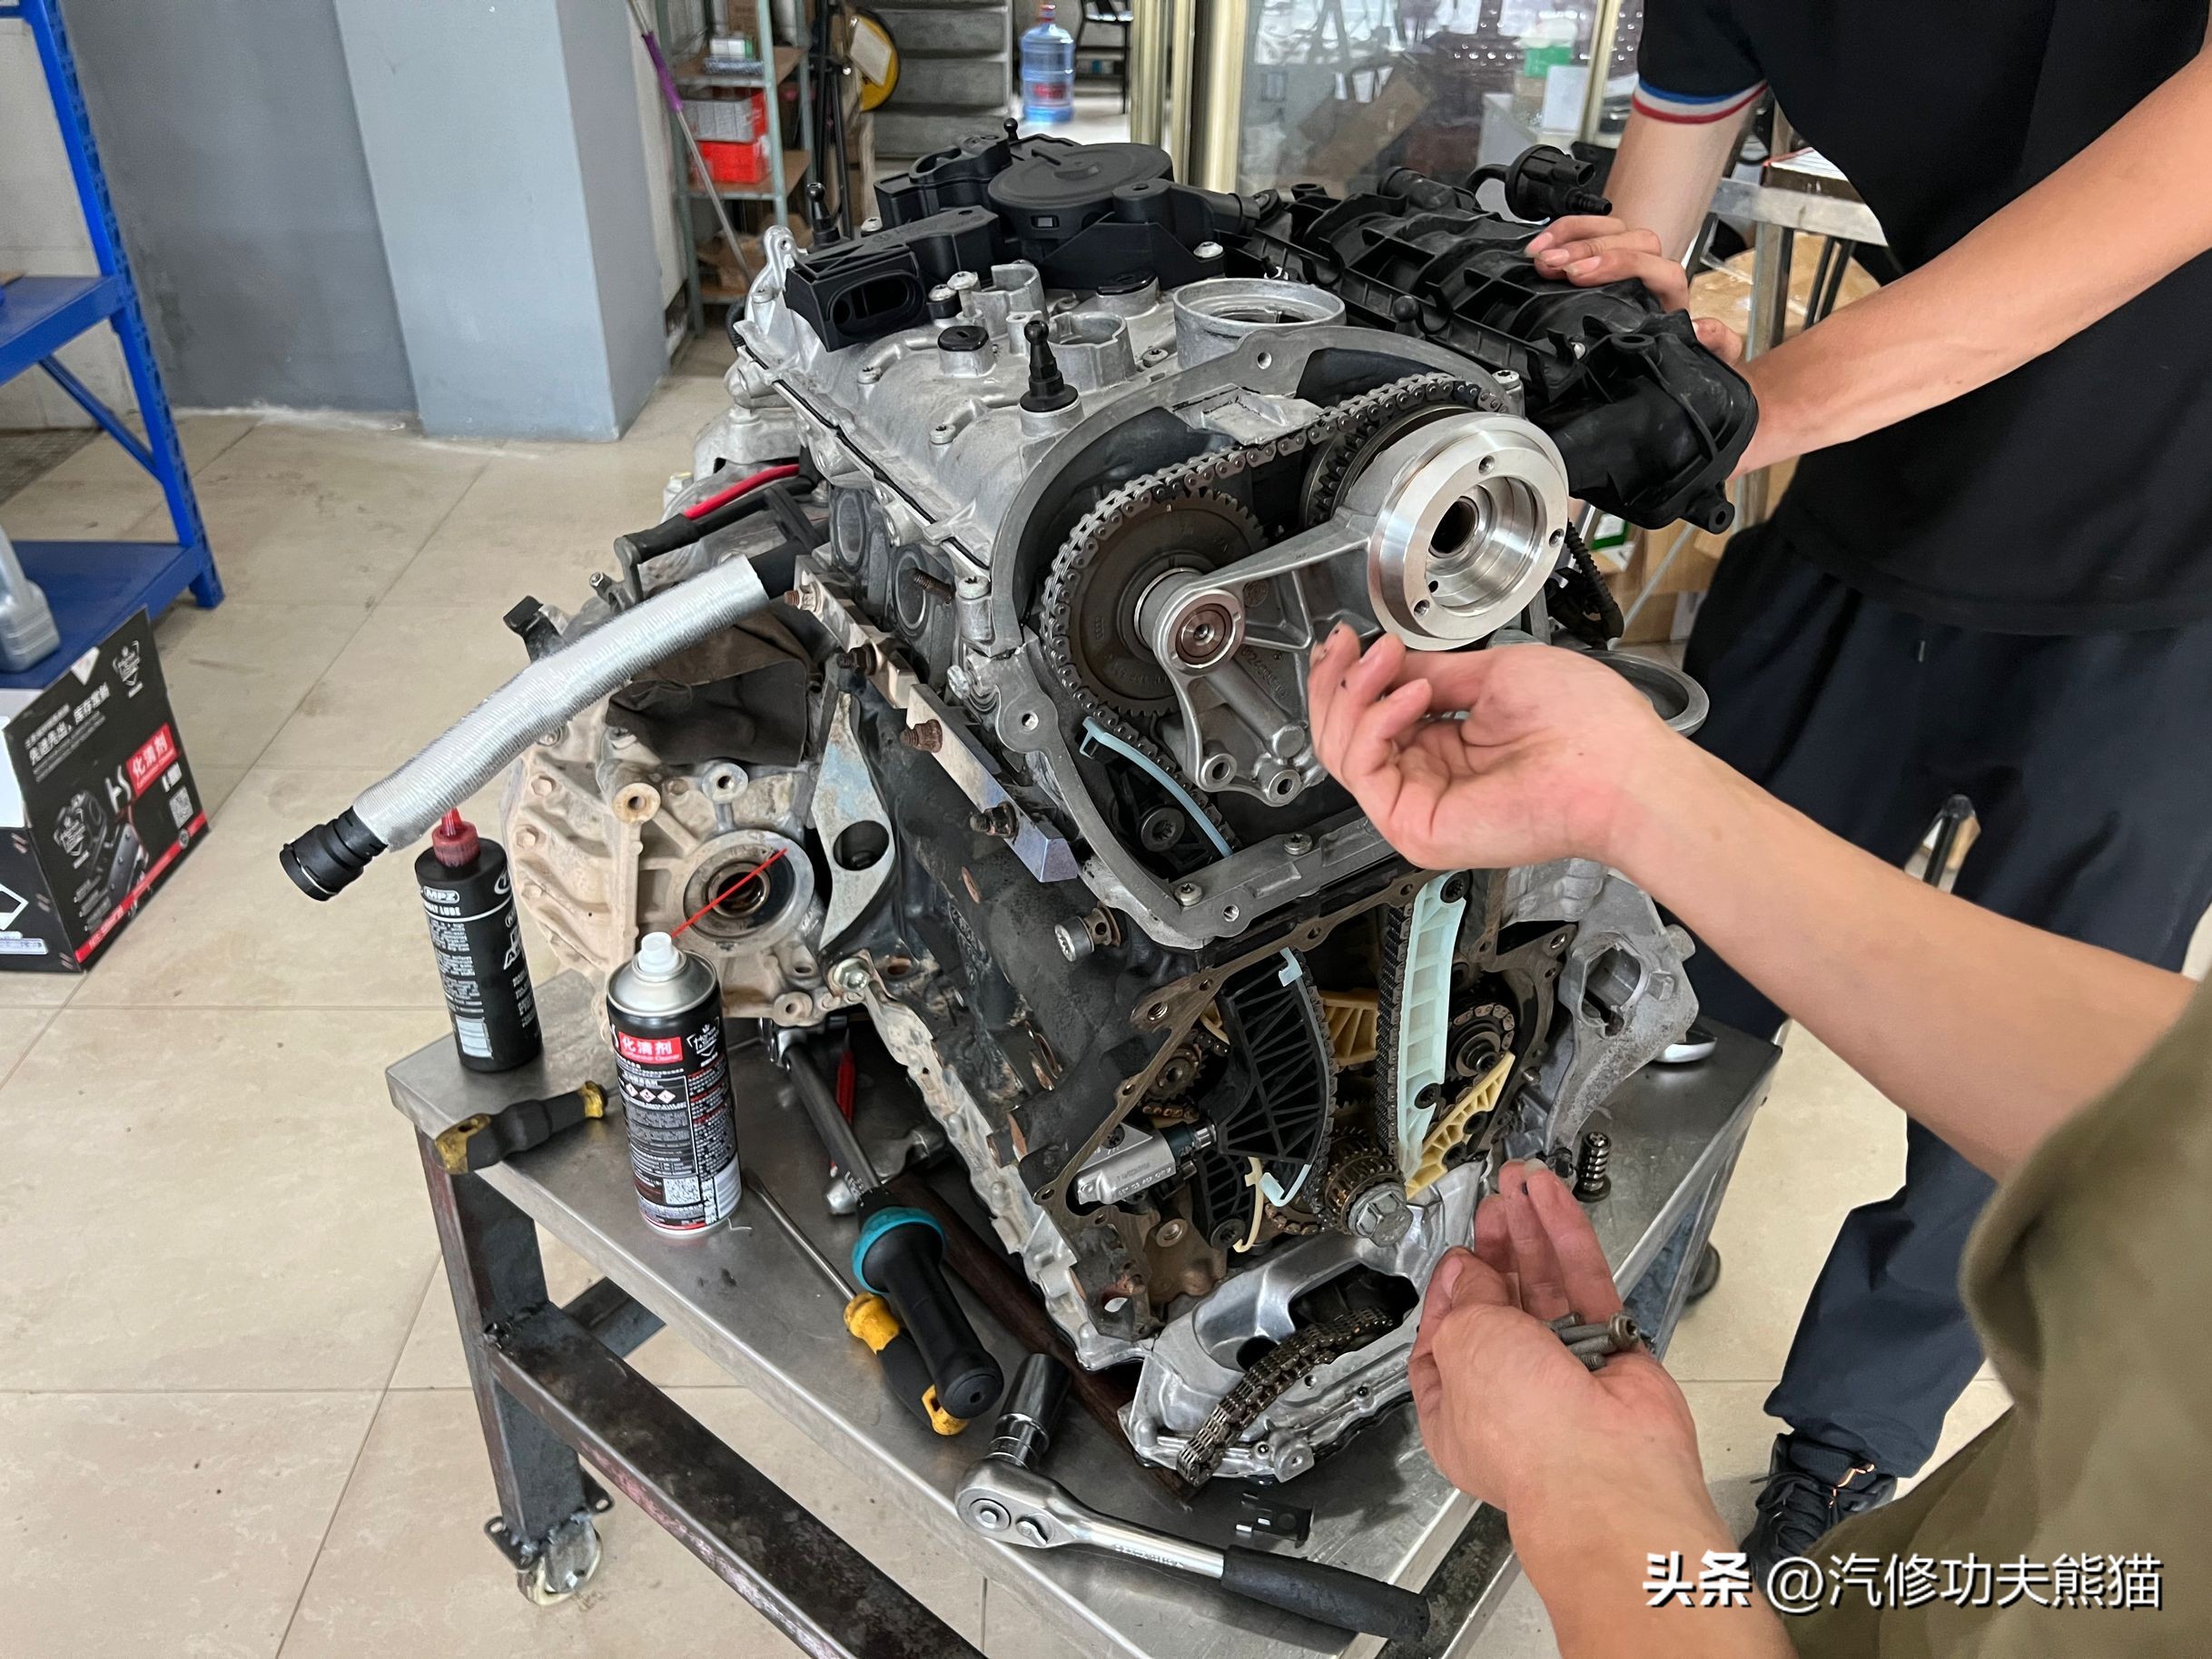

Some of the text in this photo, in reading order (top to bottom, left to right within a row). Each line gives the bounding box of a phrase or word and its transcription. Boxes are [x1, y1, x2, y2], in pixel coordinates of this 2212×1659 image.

[133, 731, 167, 775] 化清剂
[425, 889, 456, 901] MPZ
[622, 1037, 672, 1055] 化清剂
